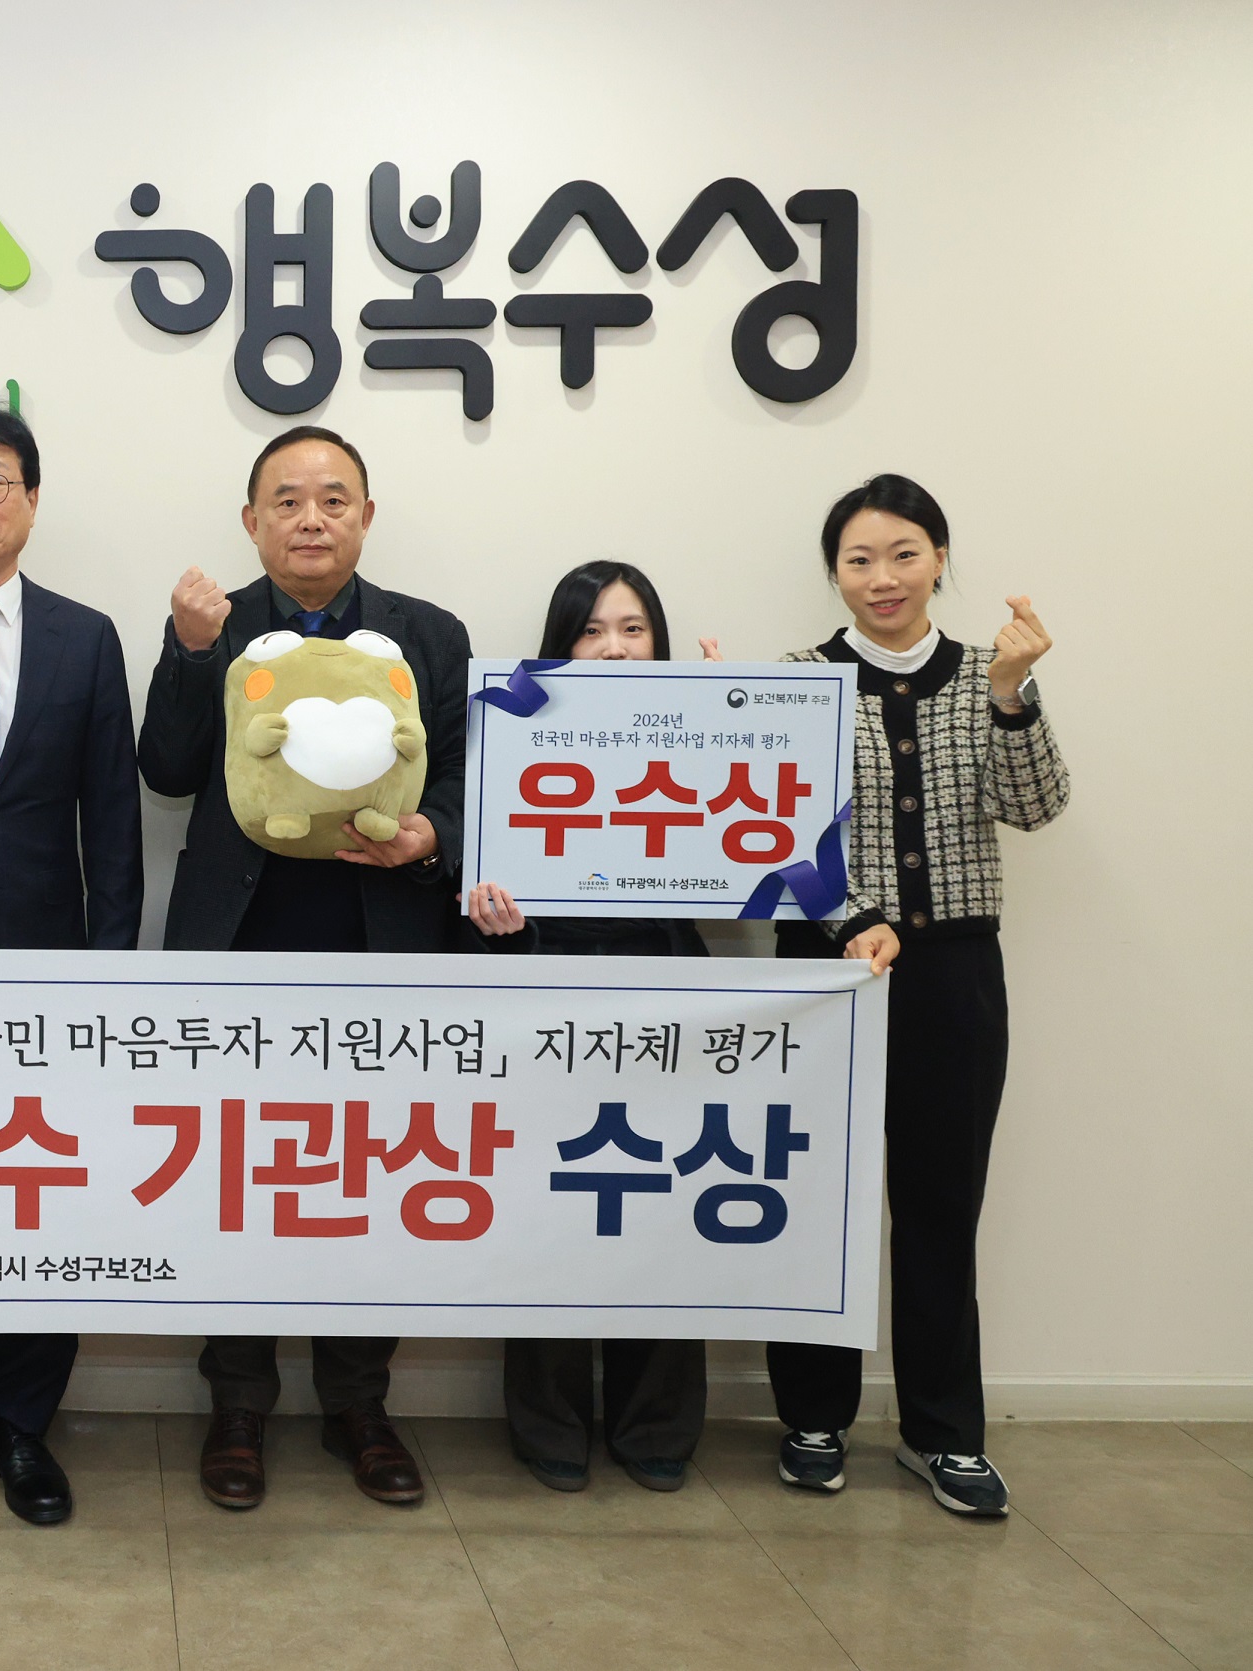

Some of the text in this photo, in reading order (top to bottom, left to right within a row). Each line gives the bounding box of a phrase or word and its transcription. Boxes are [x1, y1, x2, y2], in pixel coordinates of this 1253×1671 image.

[94, 160, 858, 421] 행복수성
[753, 693, 831, 706] 보건복지부 주관
[632, 713, 684, 730] 2024년
[530, 731, 791, 750] 전국민 마음투자 지원사업 지자체 평가
[509, 760, 812, 864] 우수상
[616, 877, 730, 891] 대구광역시 수성구보건소
[66, 1014, 274, 1071] 마음투자
[290, 1017, 508, 1079] 지원사업」
[533, 1020, 681, 1074] 지자체
[702, 1021, 801, 1075] 평가
[131, 1099, 514, 1241] 기관상
[550, 1102, 810, 1244] 수상
[34, 1255, 177, 1283] 수성구보건소
